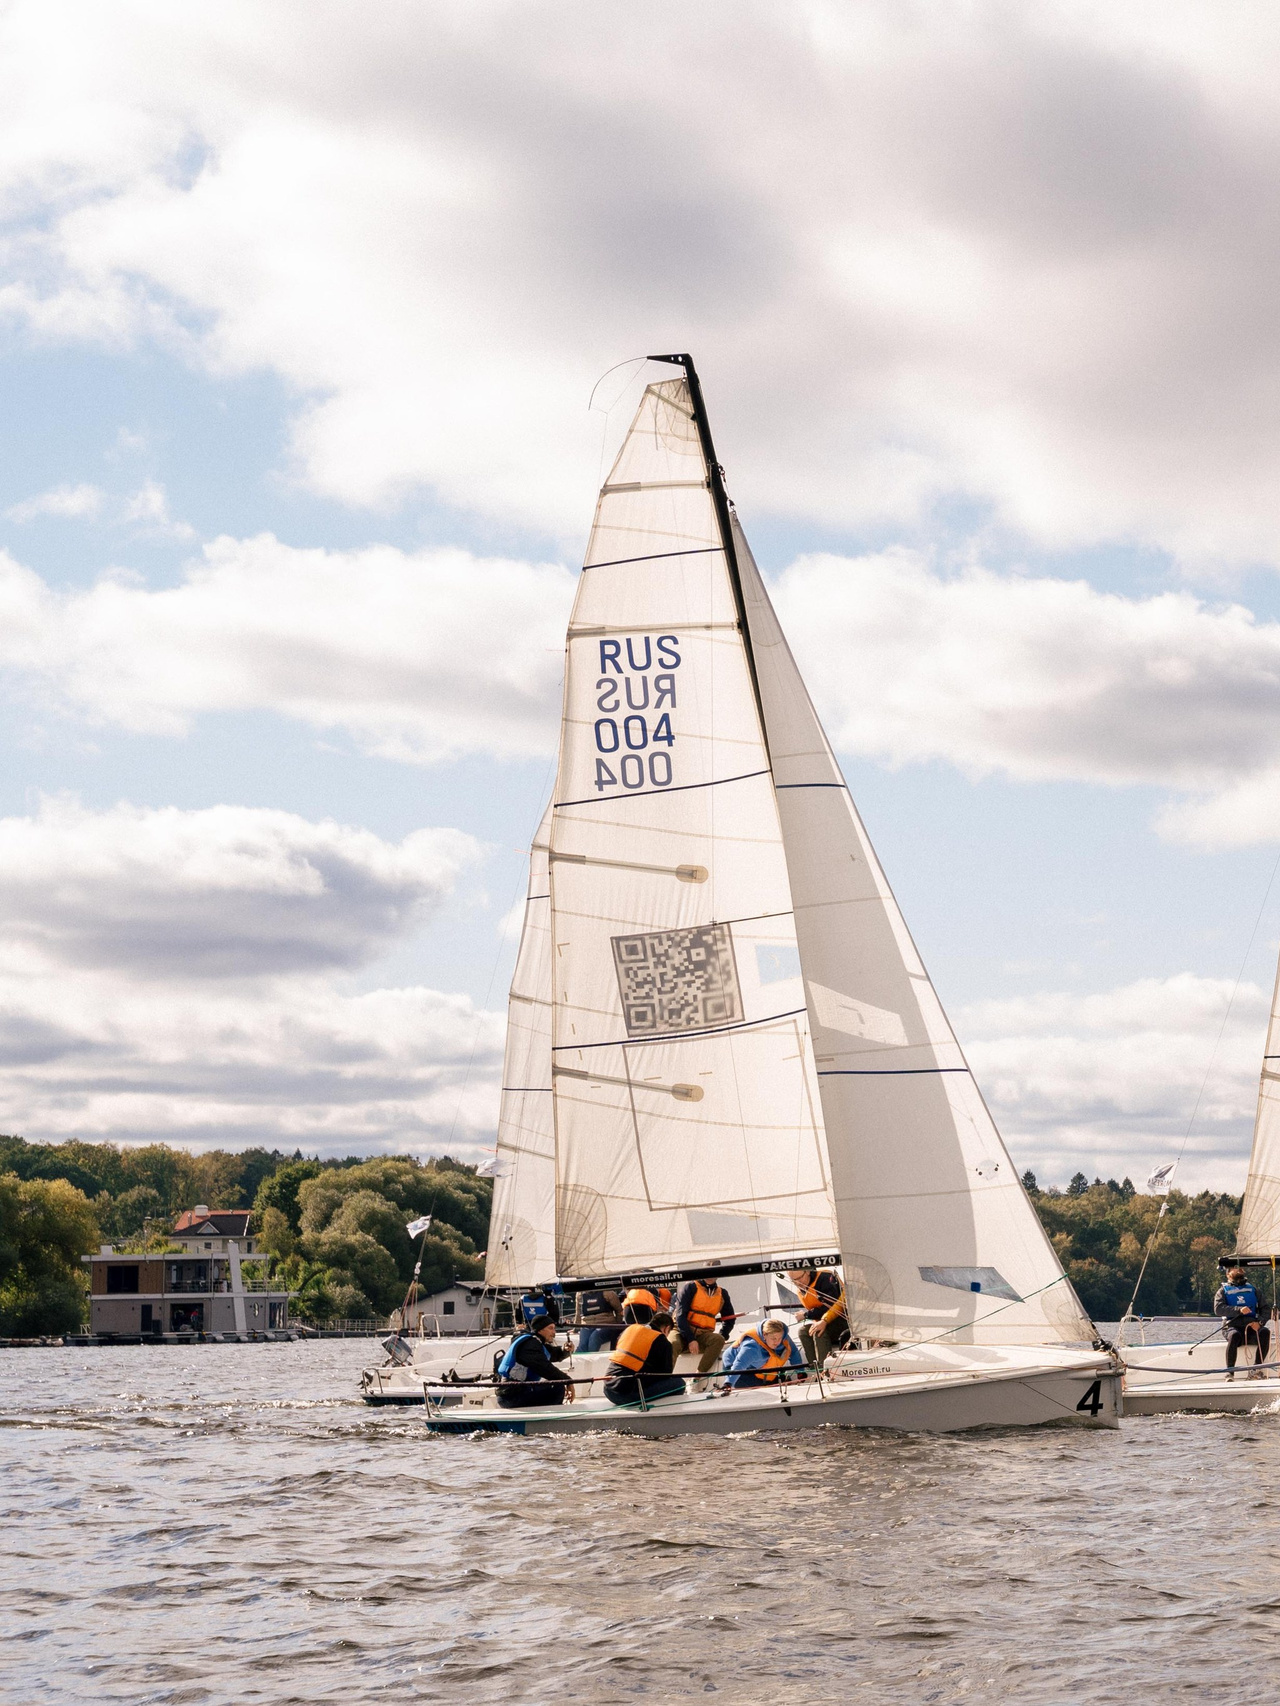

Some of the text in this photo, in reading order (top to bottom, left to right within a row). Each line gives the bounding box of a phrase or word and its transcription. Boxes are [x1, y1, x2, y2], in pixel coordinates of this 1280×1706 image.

[599, 635, 682, 674] RUS
[594, 712, 676, 753] 004
[813, 1256, 836, 1266] 670
[631, 1273, 683, 1284] moresail.ru
[841, 1366, 891, 1377] MoreSail.ru
[1076, 1380, 1104, 1417] 4
